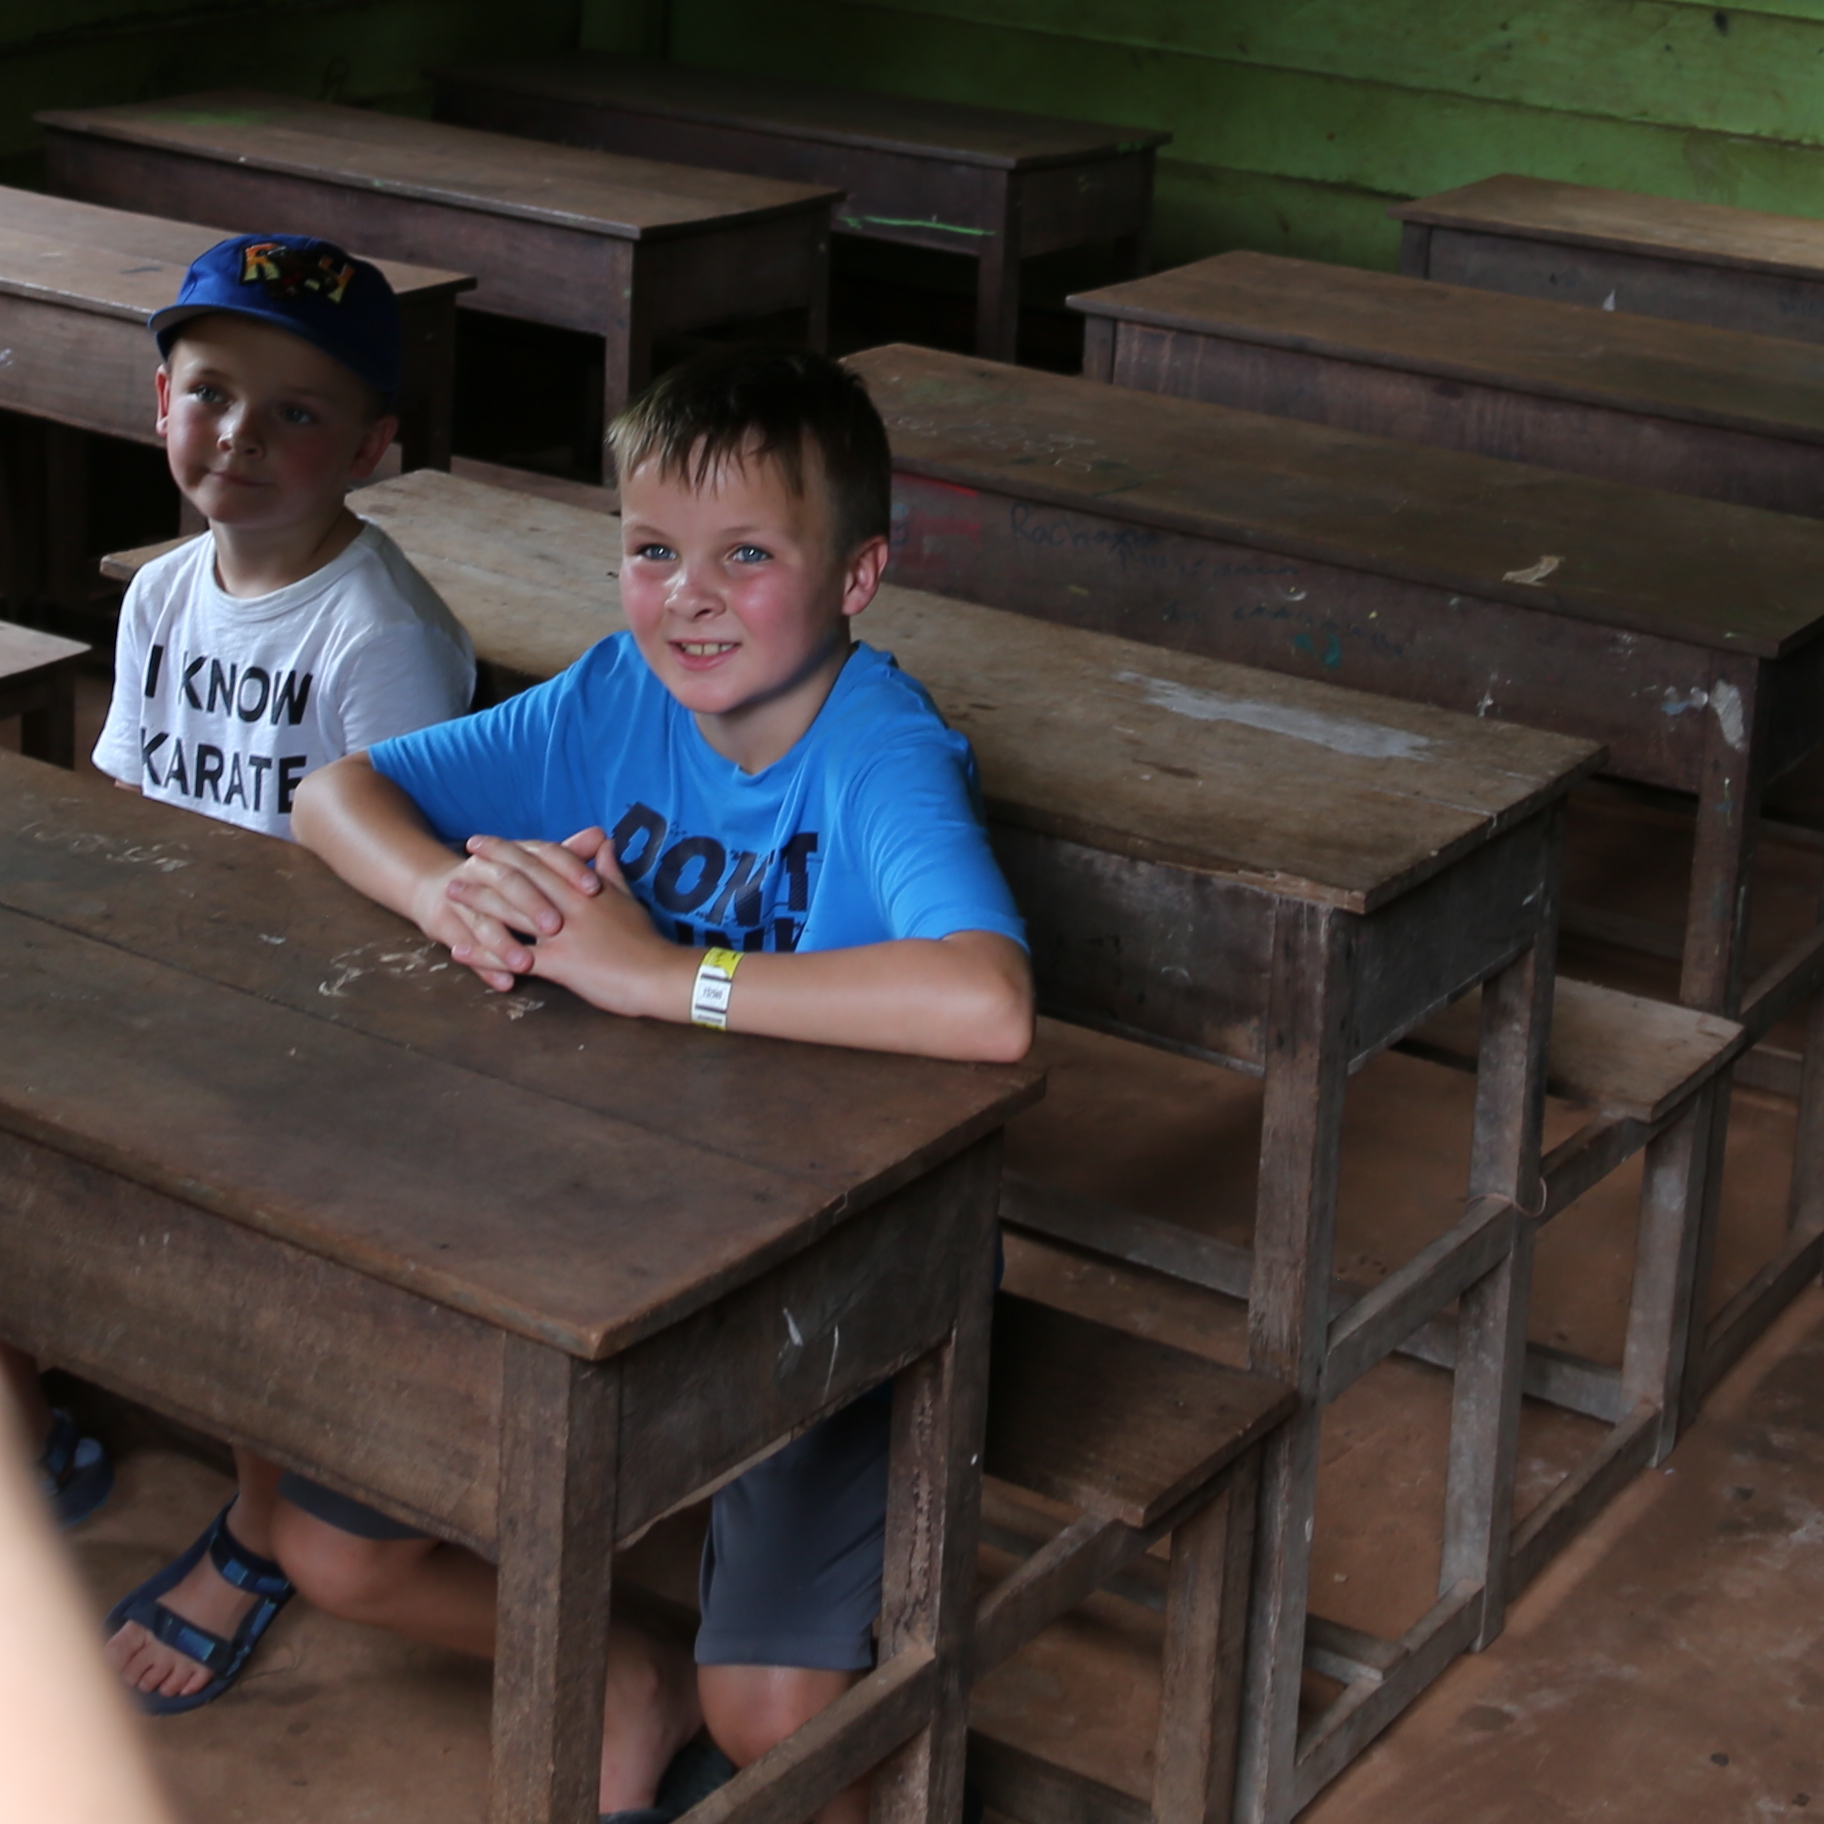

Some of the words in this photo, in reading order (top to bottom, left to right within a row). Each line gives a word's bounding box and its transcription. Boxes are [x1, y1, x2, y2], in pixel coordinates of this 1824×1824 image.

[144, 644, 163, 698] I
[179, 651, 313, 725] KNOW
[141, 728, 307, 814] KARATE
